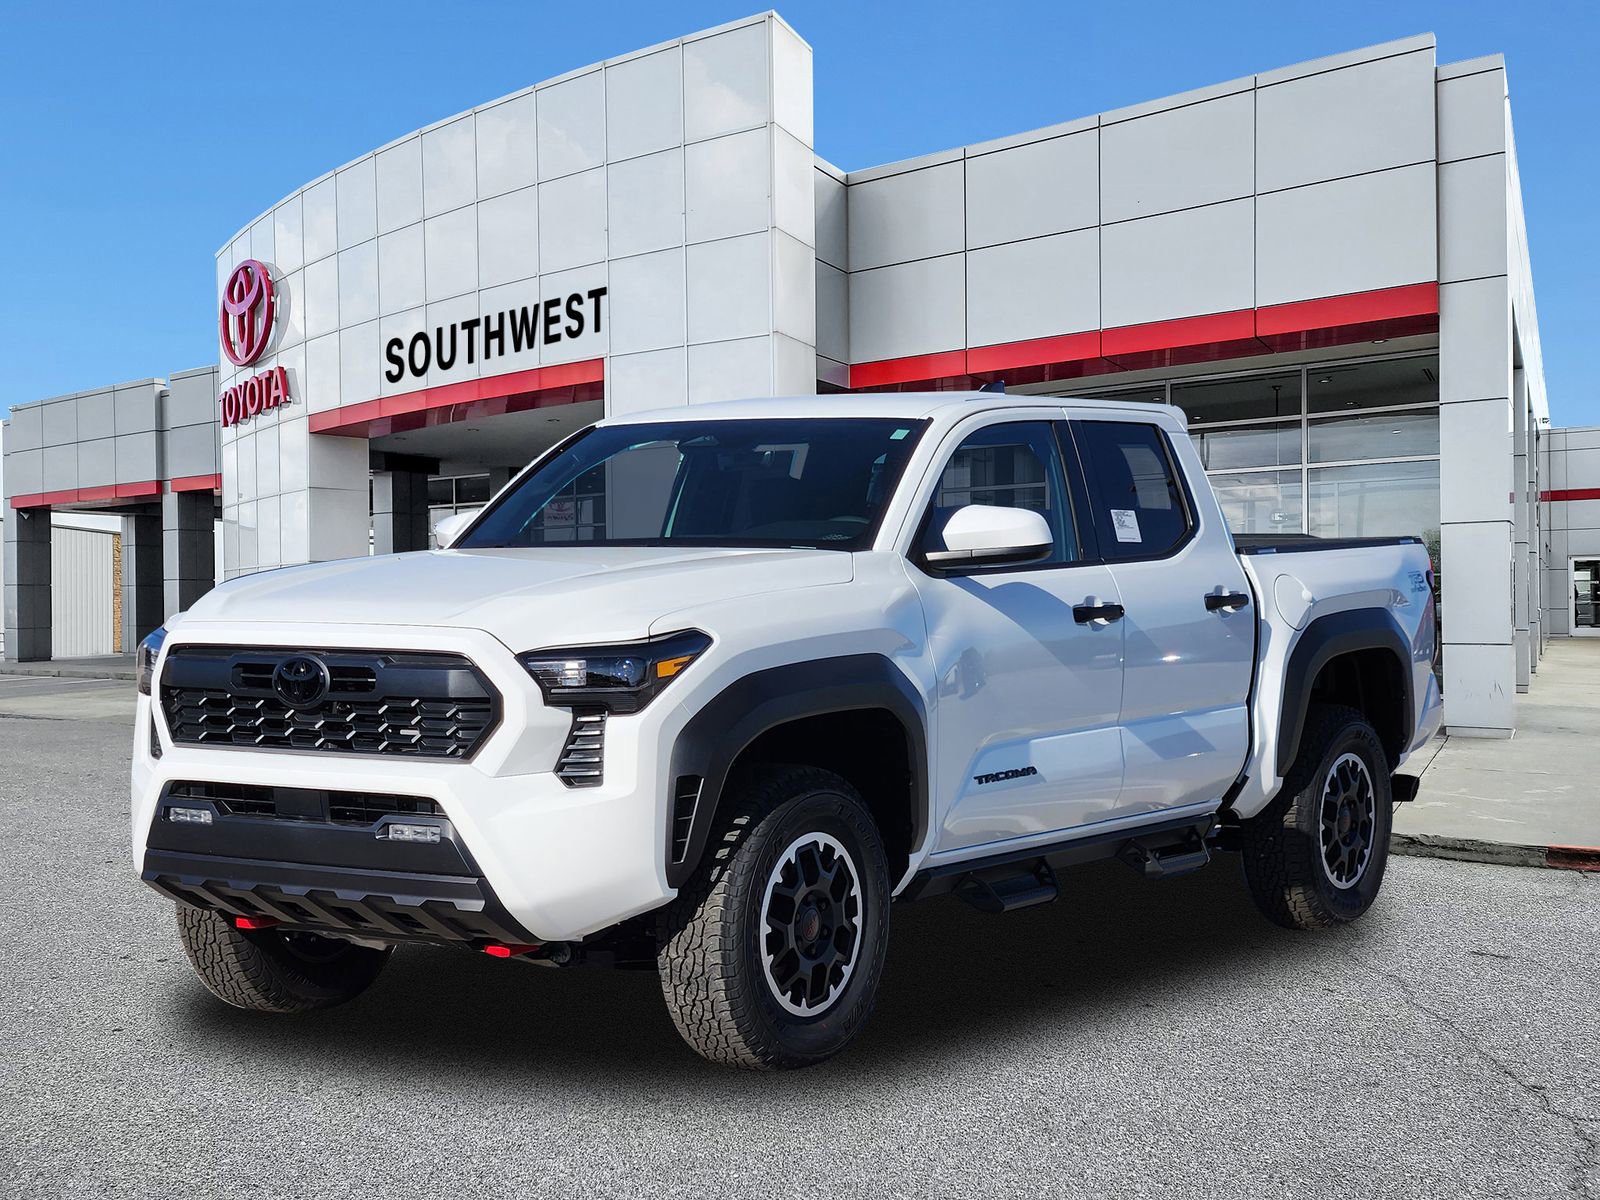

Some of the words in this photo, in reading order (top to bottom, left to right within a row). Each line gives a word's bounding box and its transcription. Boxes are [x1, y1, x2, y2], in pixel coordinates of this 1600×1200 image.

[385, 286, 607, 383] SOUTHWEST
[219, 366, 291, 428] TOYOTA
[973, 766, 1038, 785] TACOMA
